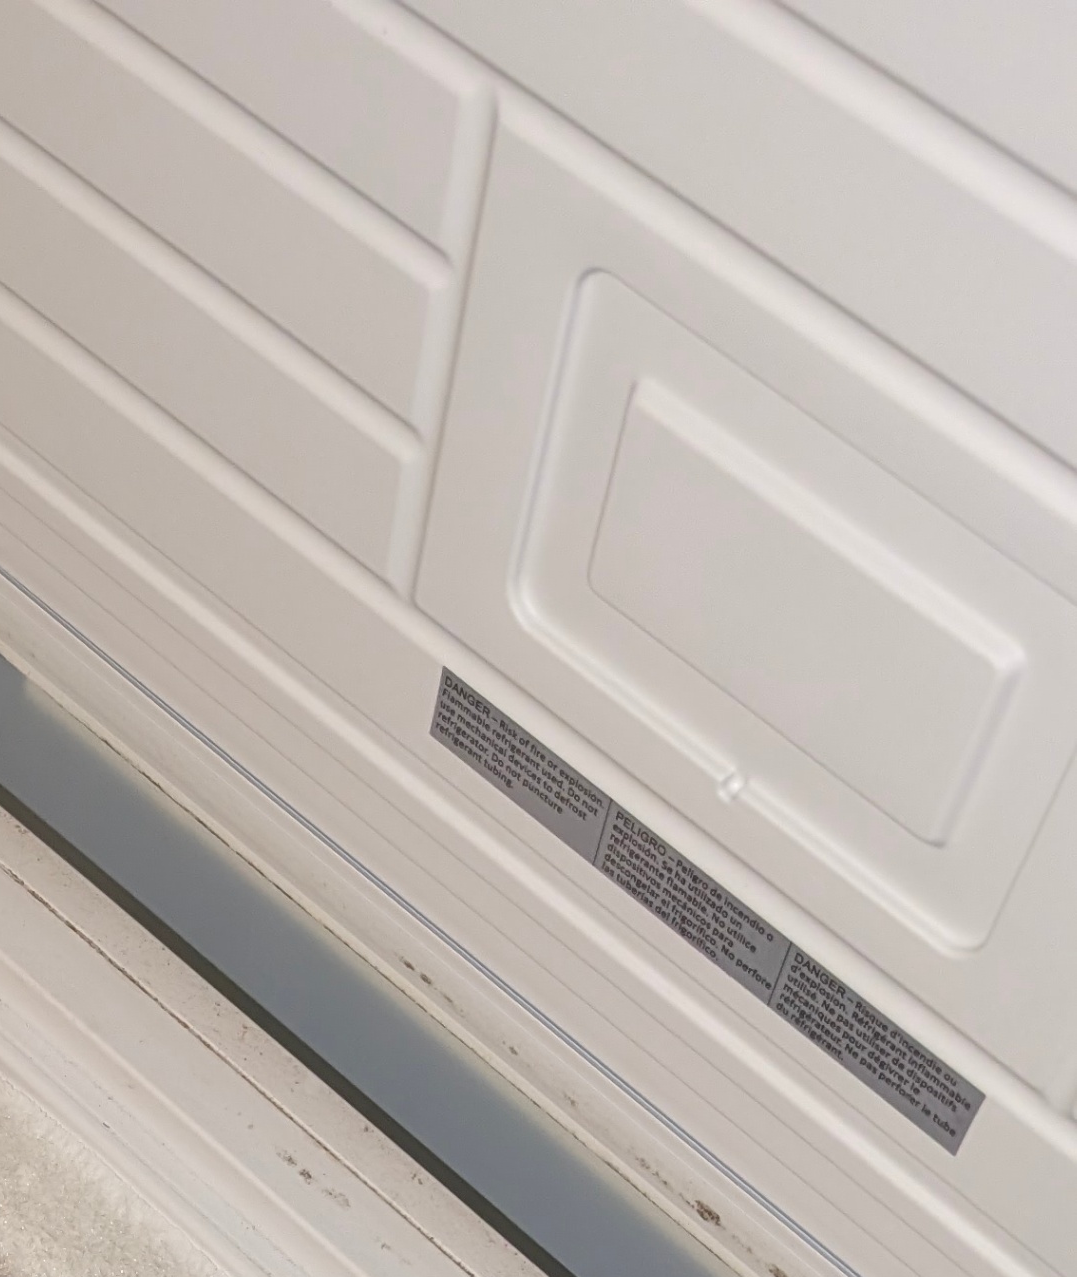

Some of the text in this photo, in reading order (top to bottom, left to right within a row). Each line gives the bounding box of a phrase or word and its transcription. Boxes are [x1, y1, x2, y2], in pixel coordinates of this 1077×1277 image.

[434, 720, 514, 790] refrigerant tubing.
[437, 709, 562, 816] refrigerator. Do not puncture
[439, 700, 587, 821] use mechanical devices to defrost
[442, 687, 598, 816] Flammable refrigerant used. Do not
[444, 675, 490, 718] DANGER
[499, 719, 518, 740] Risk
[518, 734, 529, 749] of
[529, 743, 545, 762] fire
[547, 759, 557, 772] or
[606, 840, 661, 891] dispositivos
[711, 927, 734, 950] para
[609, 830, 664, 882] refrigerante
[711, 913, 725, 929] No
[726, 924, 757, 954] utilice
[615, 809, 666, 857] PELIGRO
[675, 858, 709, 893] Peligro
[709, 886, 722, 901] de
[723, 897, 765, 935] incendio
[661, 860, 673, 875] Se
[674, 871, 686, 885] ha
[687, 881, 728, 919] utilizado
[729, 916, 742, 930] un
[794, 951, 846, 998] DANGER
[854, 1000, 889, 1034] Risque
[943, 1072, 957, 1086] ou
[907, 1056, 972, 1110] inflammable
